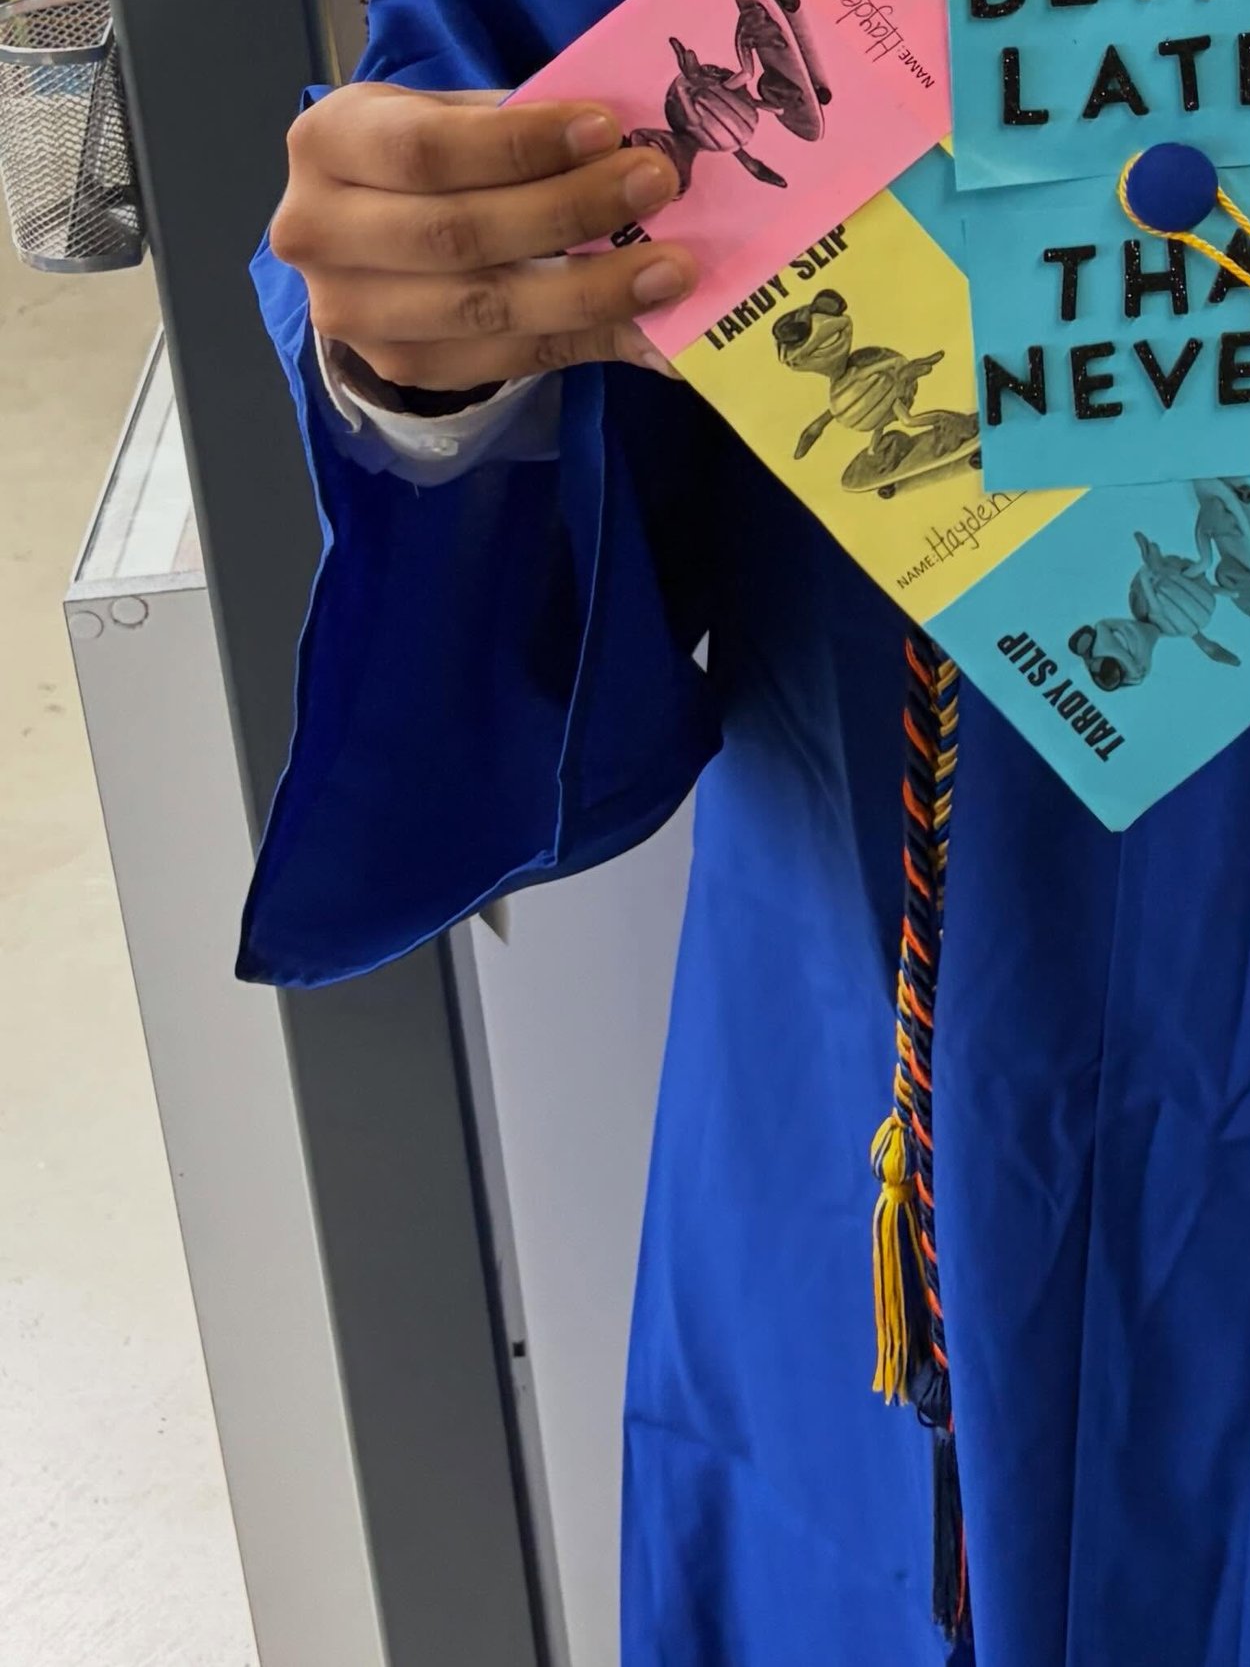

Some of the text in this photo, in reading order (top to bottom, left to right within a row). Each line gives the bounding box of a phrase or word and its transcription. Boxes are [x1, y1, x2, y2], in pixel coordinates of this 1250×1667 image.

[898, 49, 935, 89] NAME:
[789, 223, 850, 281] SLIP
[895, 552, 940, 590] NAME:
[996, 630, 1127, 763] TARDY SLIP
